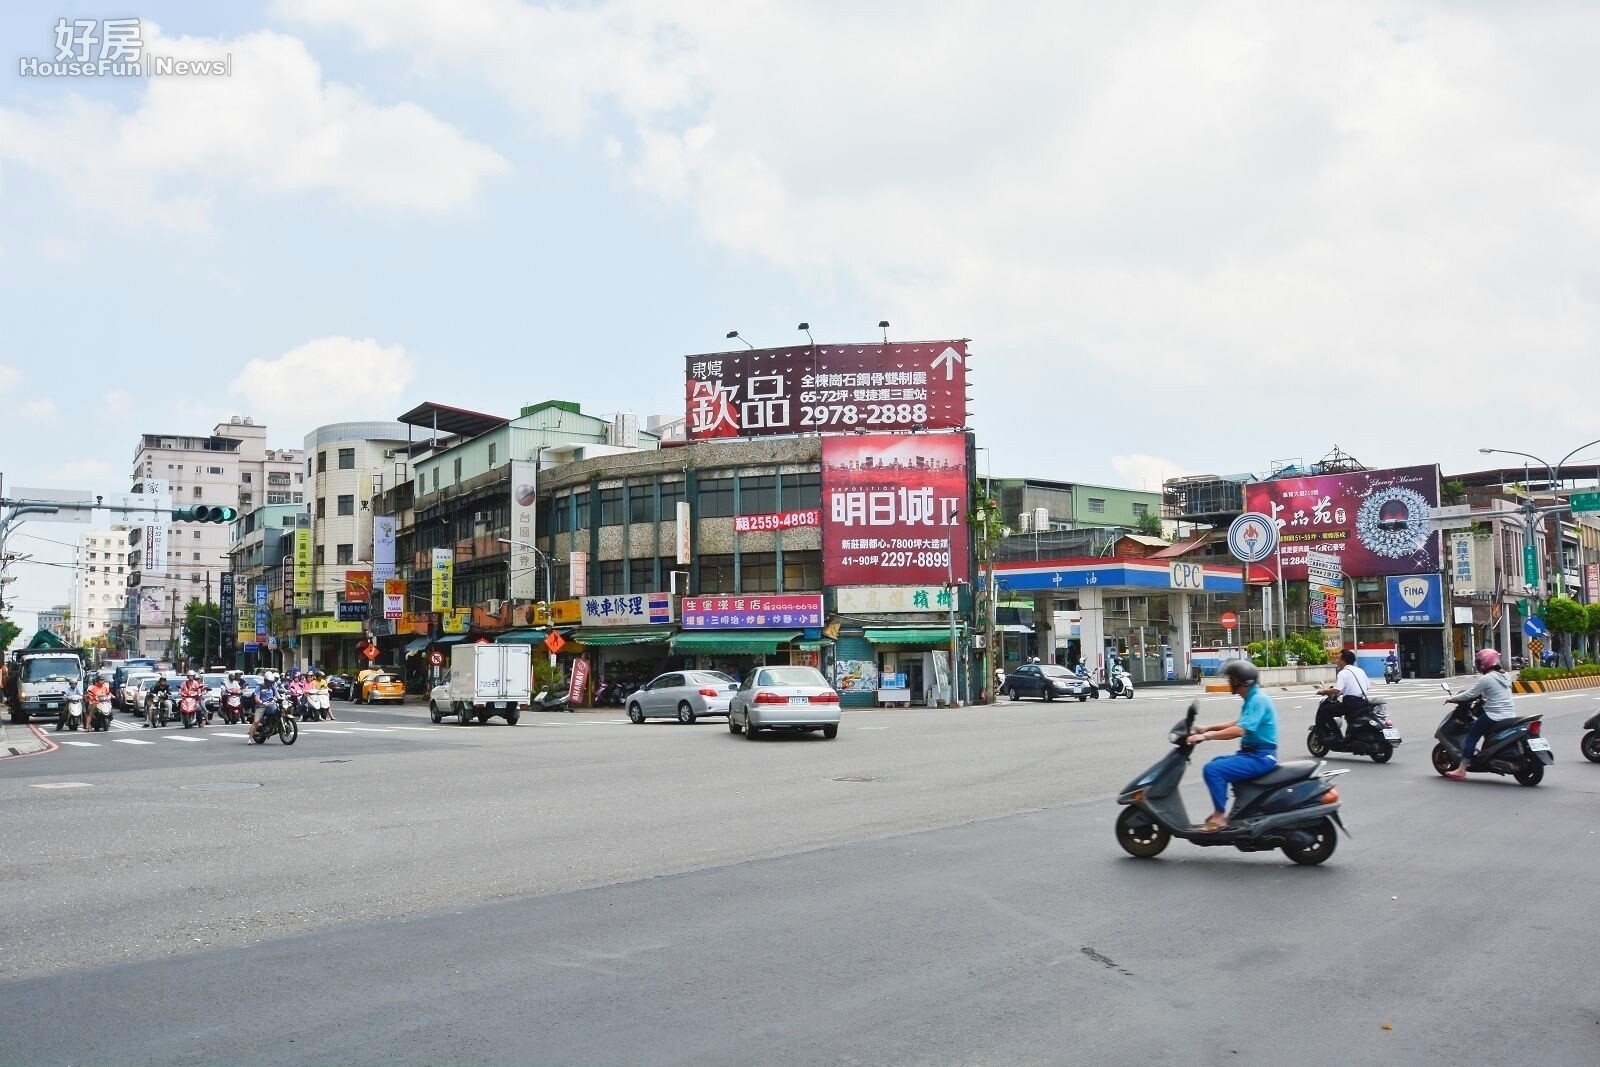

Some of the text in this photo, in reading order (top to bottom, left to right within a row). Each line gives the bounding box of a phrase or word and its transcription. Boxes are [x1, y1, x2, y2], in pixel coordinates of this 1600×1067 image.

[691, 375, 790, 432] 欽品
[800, 404, 928, 426] 2978-2888
[831, 487, 934, 526] 明日城
[880, 551, 950, 568] 2297-8899
[1052, 572, 1098, 588] 中油
[1173, 563, 1201, 589] CPC
[1404, 586, 1424, 596] FINA
[585, 596, 644, 617] 機車修理
